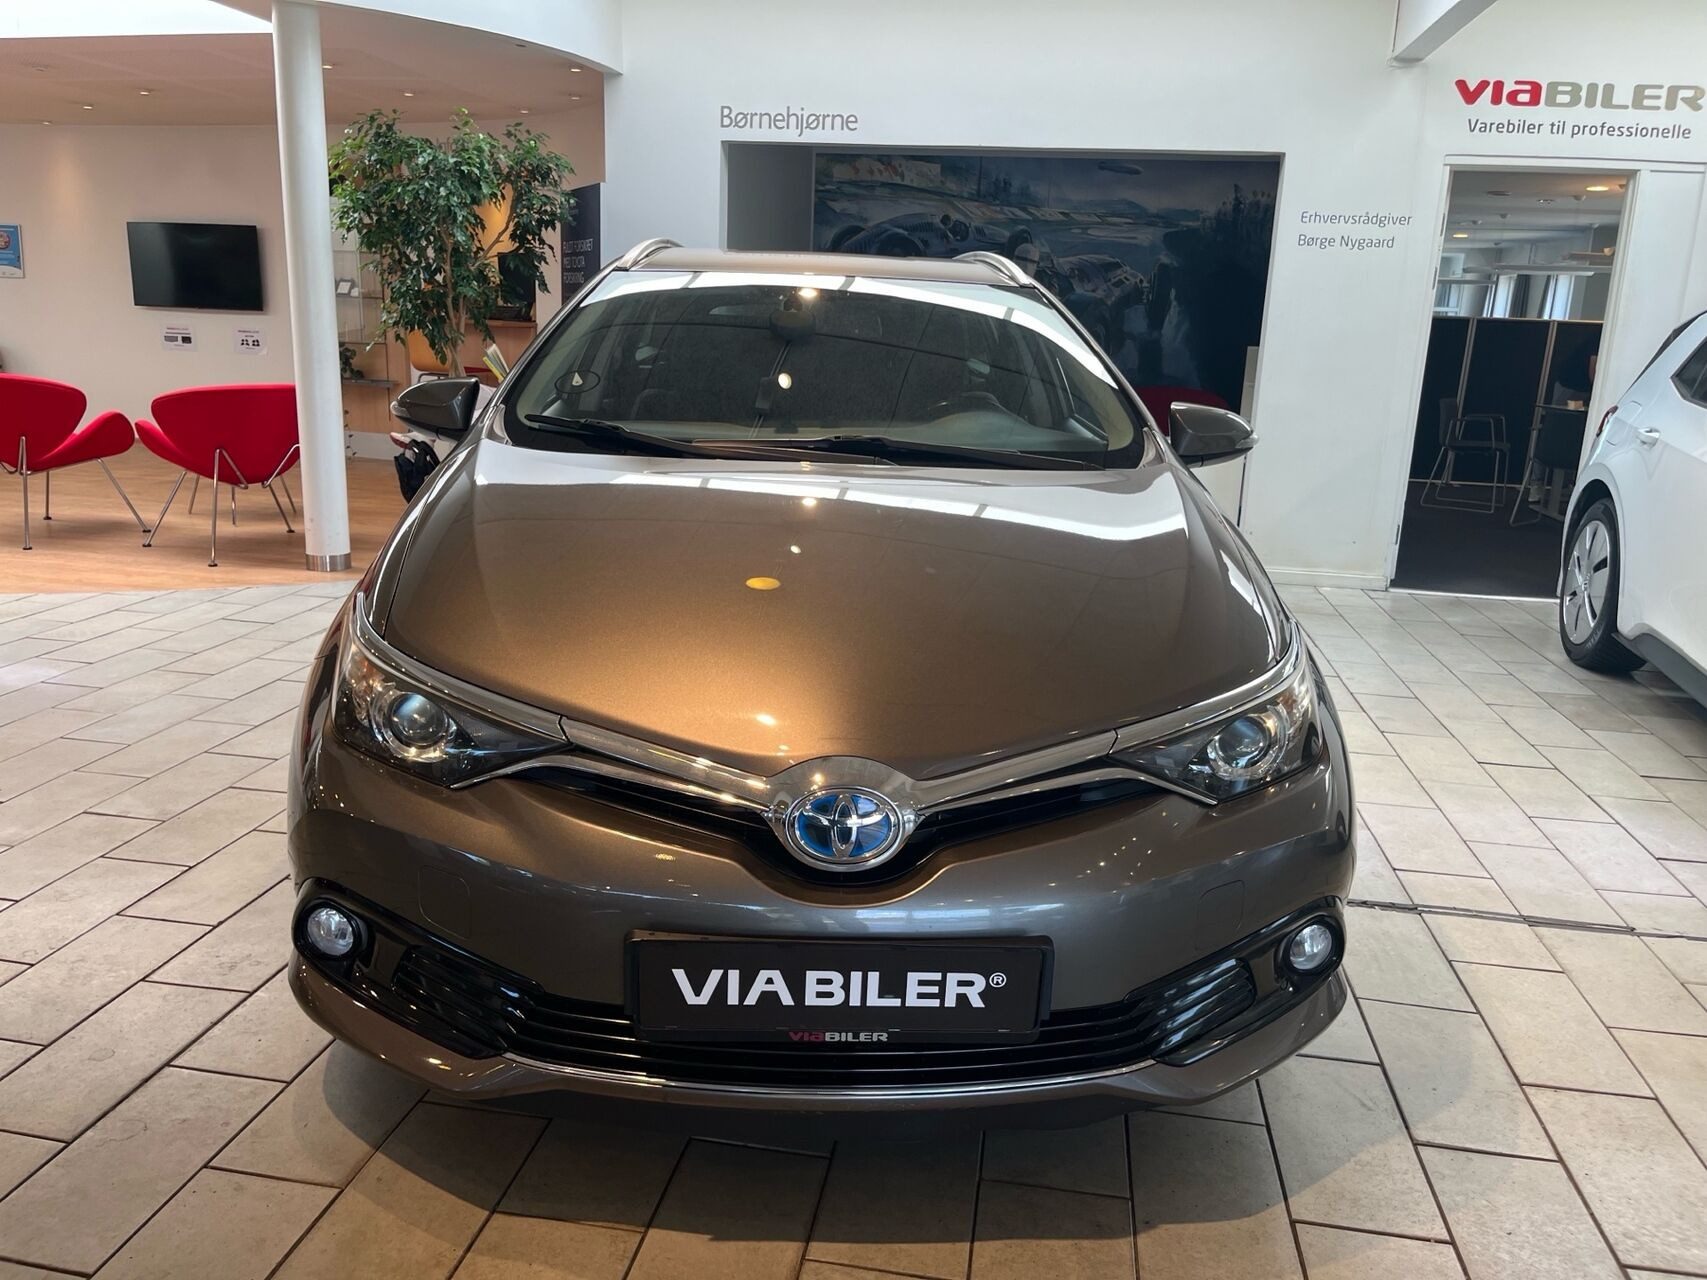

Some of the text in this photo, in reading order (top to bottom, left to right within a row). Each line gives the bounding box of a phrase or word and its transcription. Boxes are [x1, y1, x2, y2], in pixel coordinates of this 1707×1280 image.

[720, 105, 858, 137] Børnehjørne
[1467, 118, 1692, 139] Varebiler til professionelle
[1300, 211, 1413, 228] Erhvervsrådgiver
[1297, 233, 1395, 251] Børge Nygaard
[671, 968, 795, 1006] VIA
